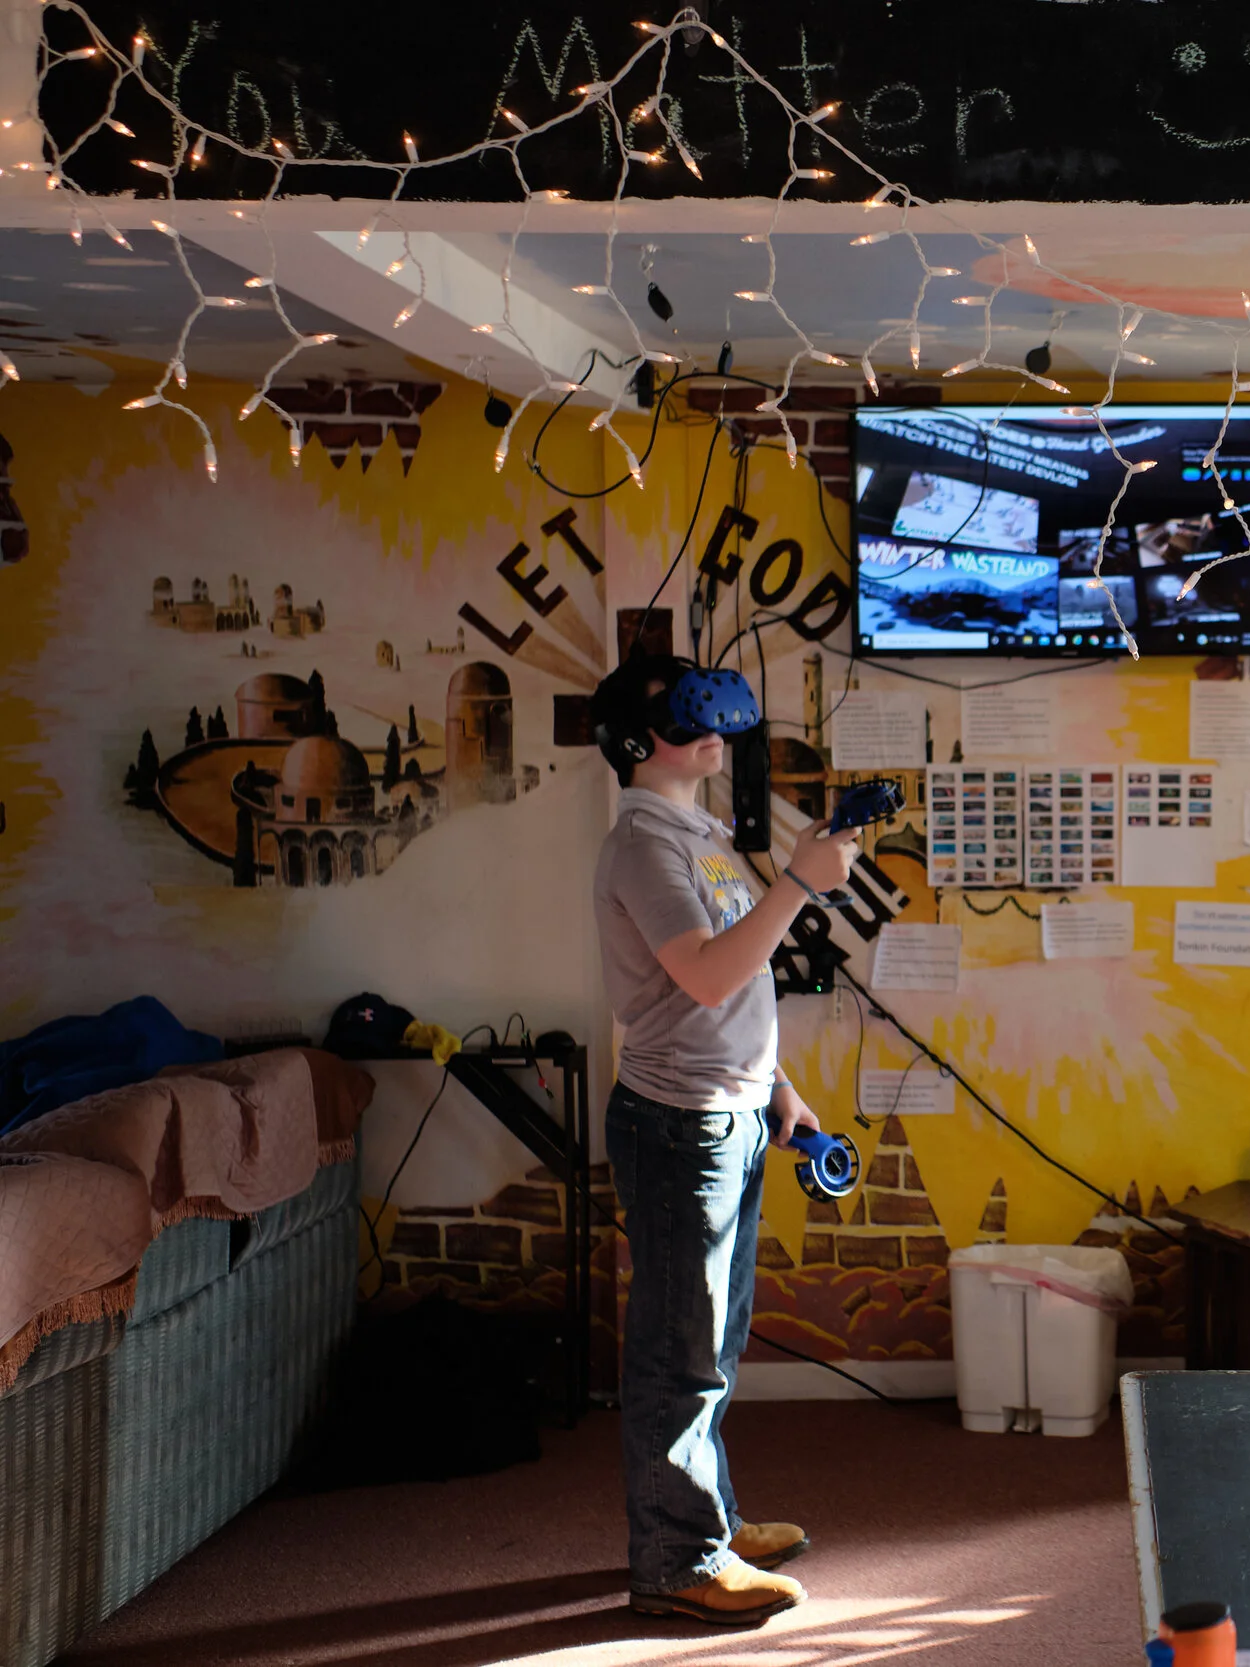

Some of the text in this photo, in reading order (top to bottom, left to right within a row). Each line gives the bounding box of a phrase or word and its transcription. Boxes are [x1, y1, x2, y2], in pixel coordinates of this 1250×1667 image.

[138, 15, 1015, 168] You Matter
[936, 437, 969, 457] THE
[458, 504, 850, 656] LET GOD
[858, 541, 1050, 577] WINTER WASTELAND
